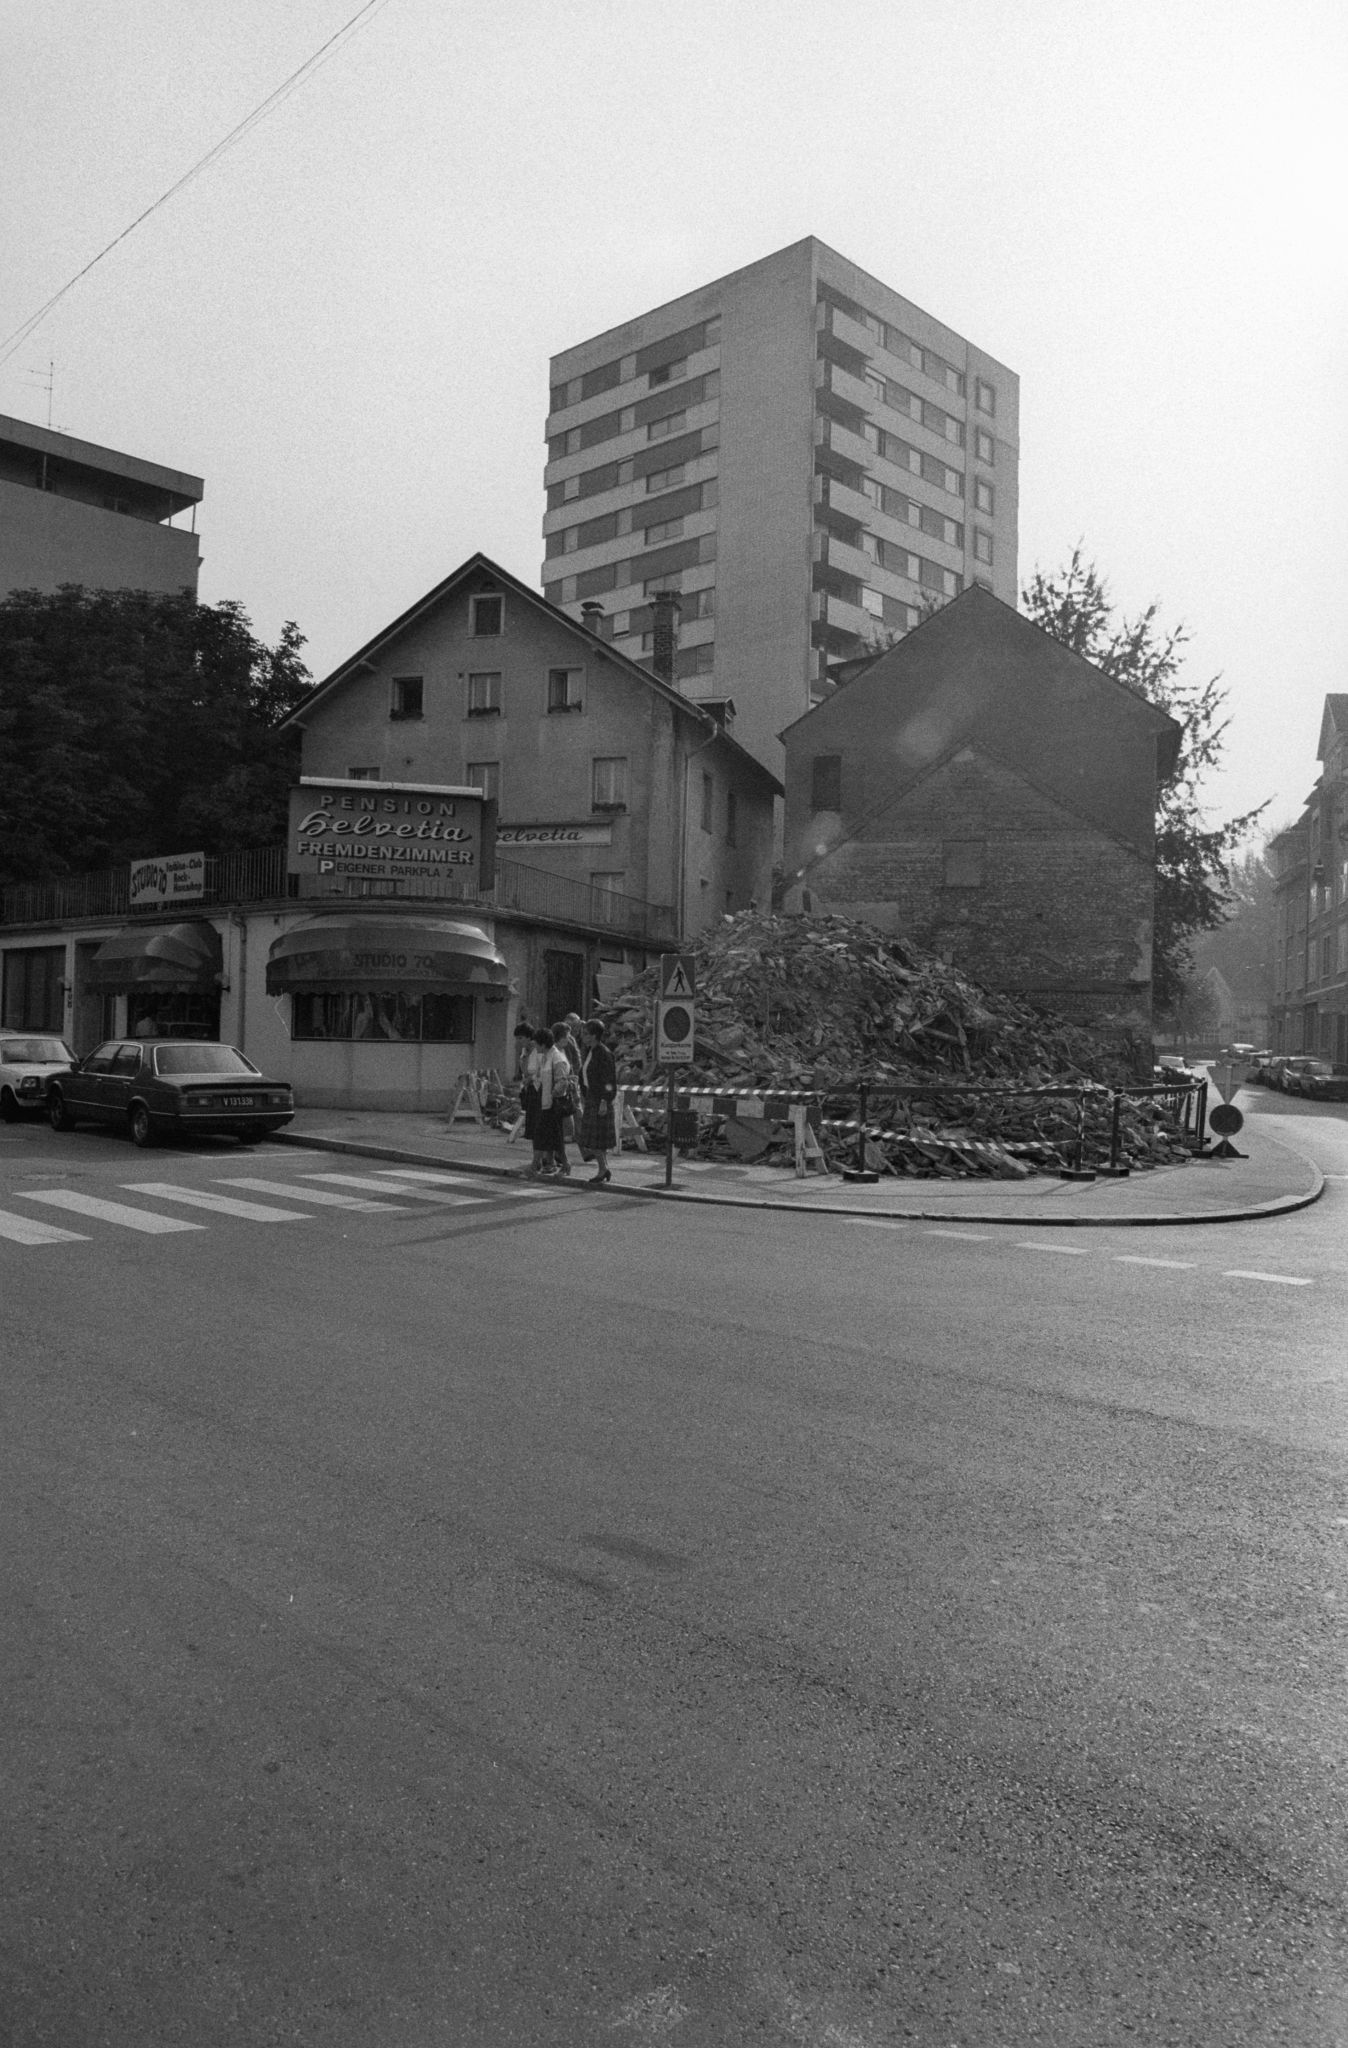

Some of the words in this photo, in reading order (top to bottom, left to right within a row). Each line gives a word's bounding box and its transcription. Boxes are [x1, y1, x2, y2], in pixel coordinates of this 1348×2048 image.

[320, 795, 456, 817] PENSION
[496, 827, 582, 842] elvetia
[297, 841, 474, 864] FREMDENZIMMER
[320, 860, 334, 874] P
[337, 862, 386, 875] EIGENER
[132, 864, 157, 897] STUDIO
[353, 953, 406, 969] STUDIO
[413, 955, 434, 970] 70
